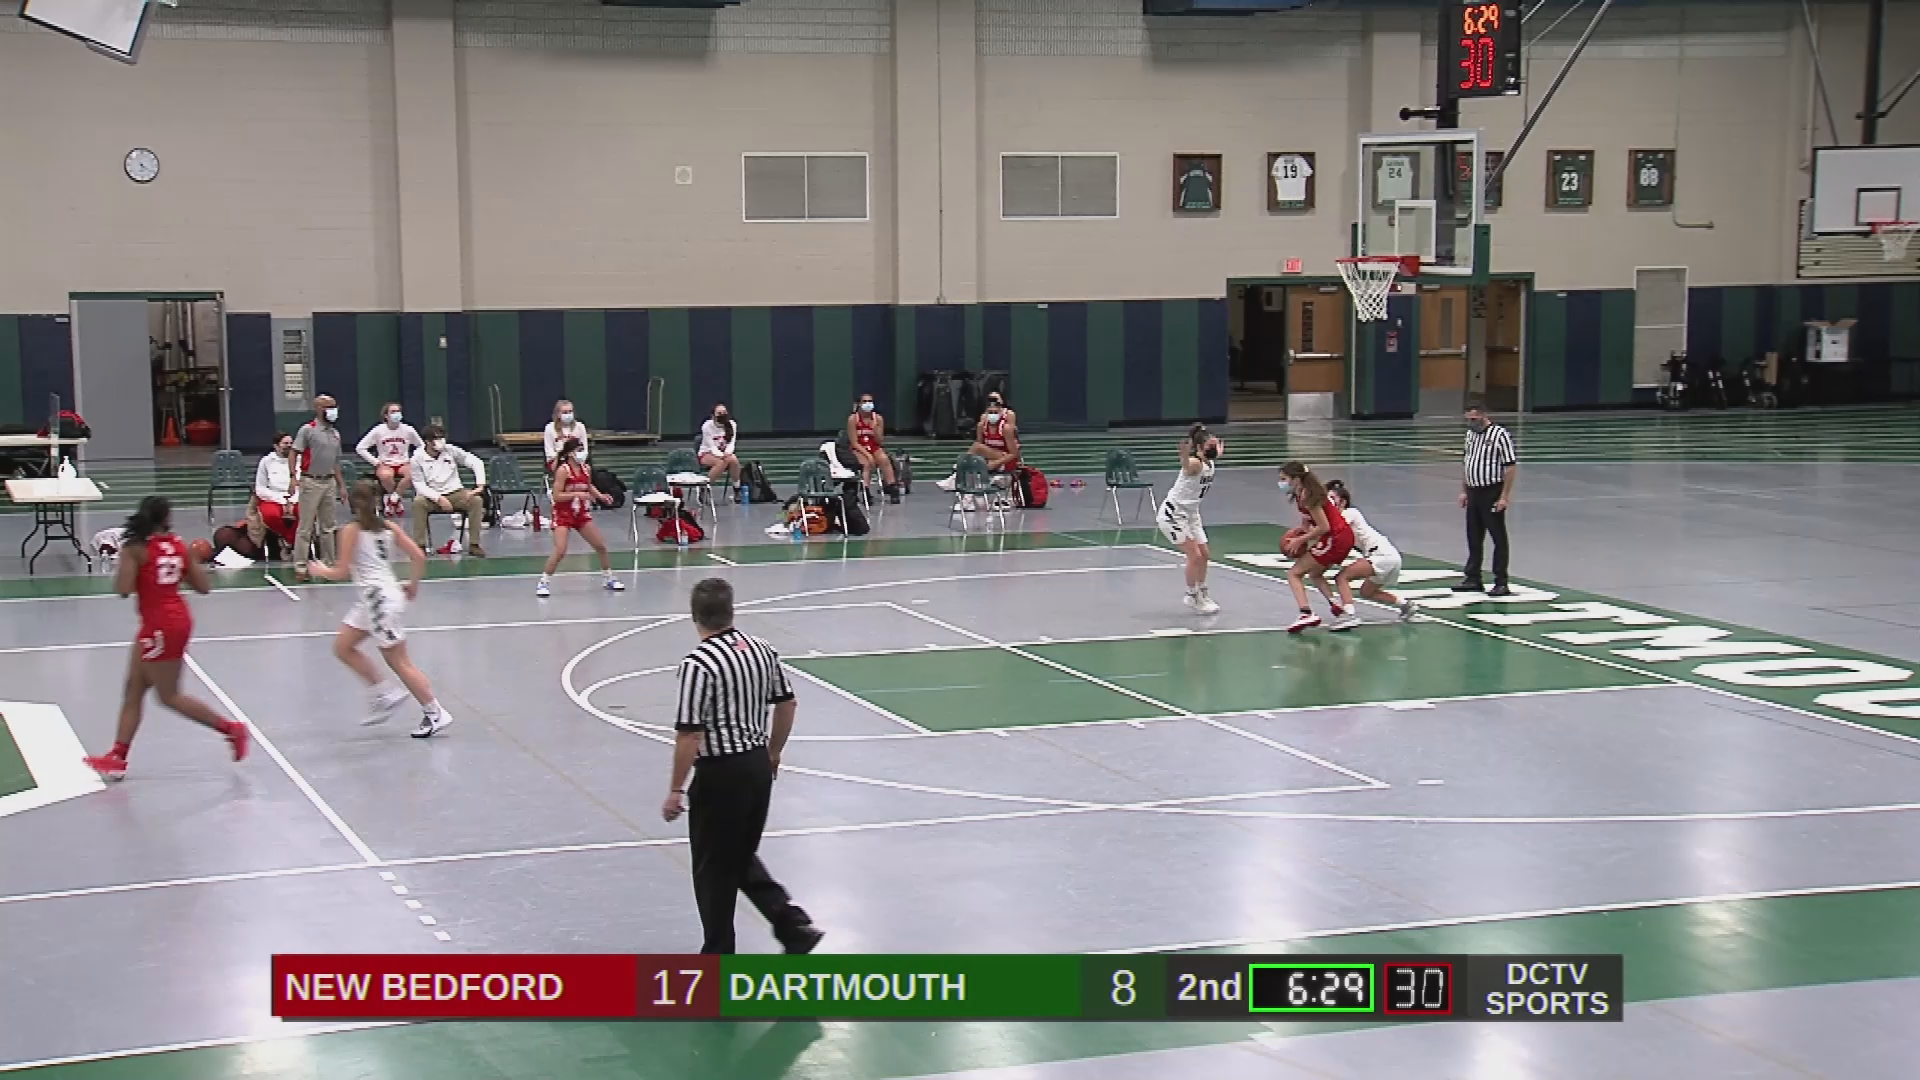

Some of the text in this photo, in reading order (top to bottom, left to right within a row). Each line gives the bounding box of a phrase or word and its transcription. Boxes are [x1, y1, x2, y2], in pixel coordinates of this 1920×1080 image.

[1463, 4, 1499, 35] 6:29
[1460, 37, 1495, 89] 30
[1283, 165, 1298, 179] 19
[1388, 167, 1403, 179] 24
[1561, 172, 1579, 191] 23
